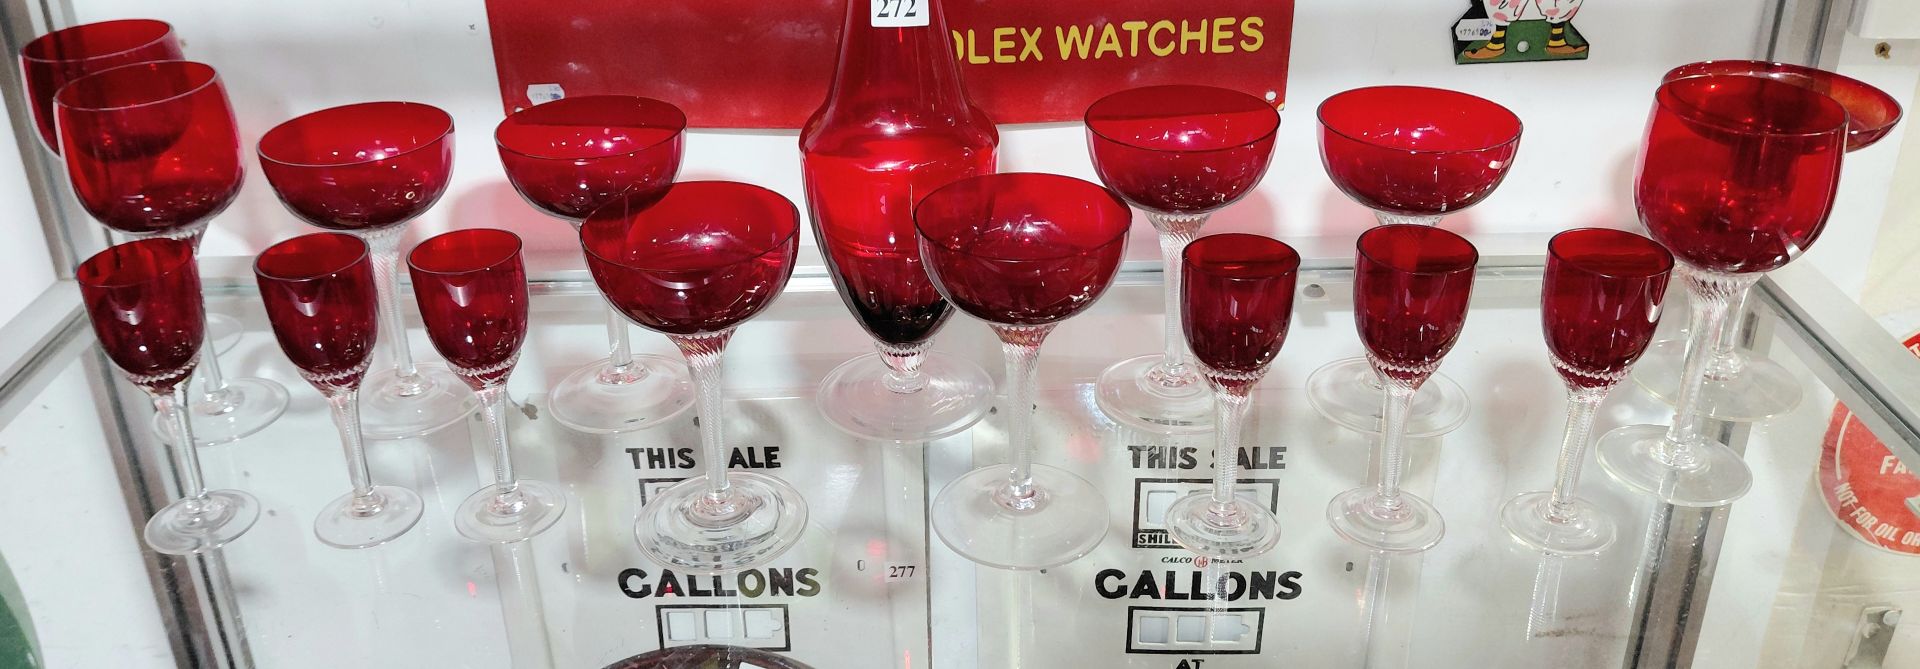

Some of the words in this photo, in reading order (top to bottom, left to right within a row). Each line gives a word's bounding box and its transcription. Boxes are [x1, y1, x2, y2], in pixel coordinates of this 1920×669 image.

[876, 0, 917, 18] 272
[1056, 16, 1265, 61] WATCHES
[625, 447, 696, 470] THIS
[728, 446, 782, 469] ALE
[1127, 445, 1198, 470] THIS
[1210, 446, 1287, 470] ALE
[1880, 455, 1914, 475] FA
[1833, 482, 1859, 508] NOT
[1849, 506, 1879, 530] FOR
[1874, 522, 1899, 542] OIL
[889, 565, 916, 578] 277
[1161, 556, 1193, 564] CALCO
[617, 567, 821, 599] GALLONS
[1095, 568, 1303, 601] GALLONS
[1176, 658, 1205, 669] AT
